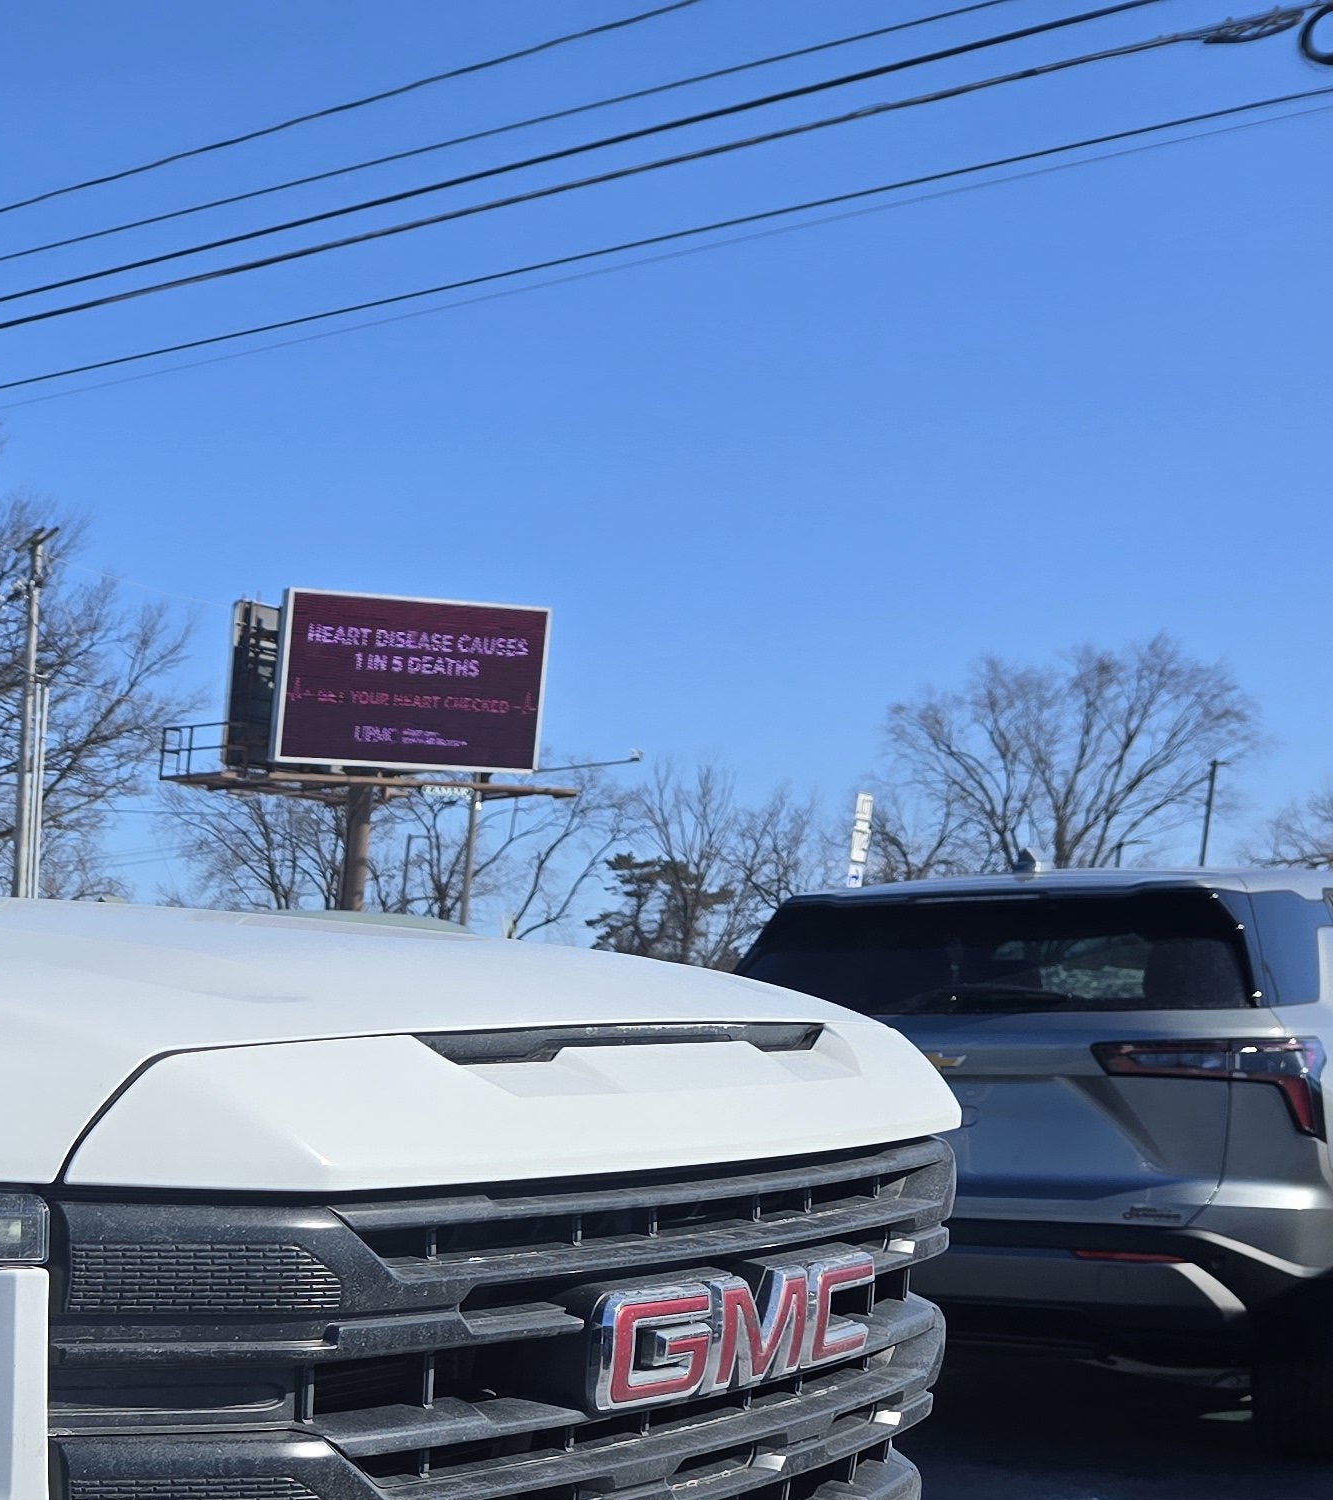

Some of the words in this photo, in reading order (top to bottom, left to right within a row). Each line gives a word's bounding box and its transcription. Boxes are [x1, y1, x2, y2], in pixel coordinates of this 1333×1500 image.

[307, 623, 371, 646] HEART
[375, 628, 453, 653] DISEASE
[457, 634, 529, 657] CAUSES
[355, 651, 364, 670] 1
[367, 653, 388, 671] IN
[391, 655, 404, 673] 5
[407, 656, 480, 677] DEATHS
[349, 690, 389, 706] YOUR
[393, 693, 441, 709] HEART
[444, 696, 509, 714] CHECKED
[596, 1251, 875, 1411] GMC
